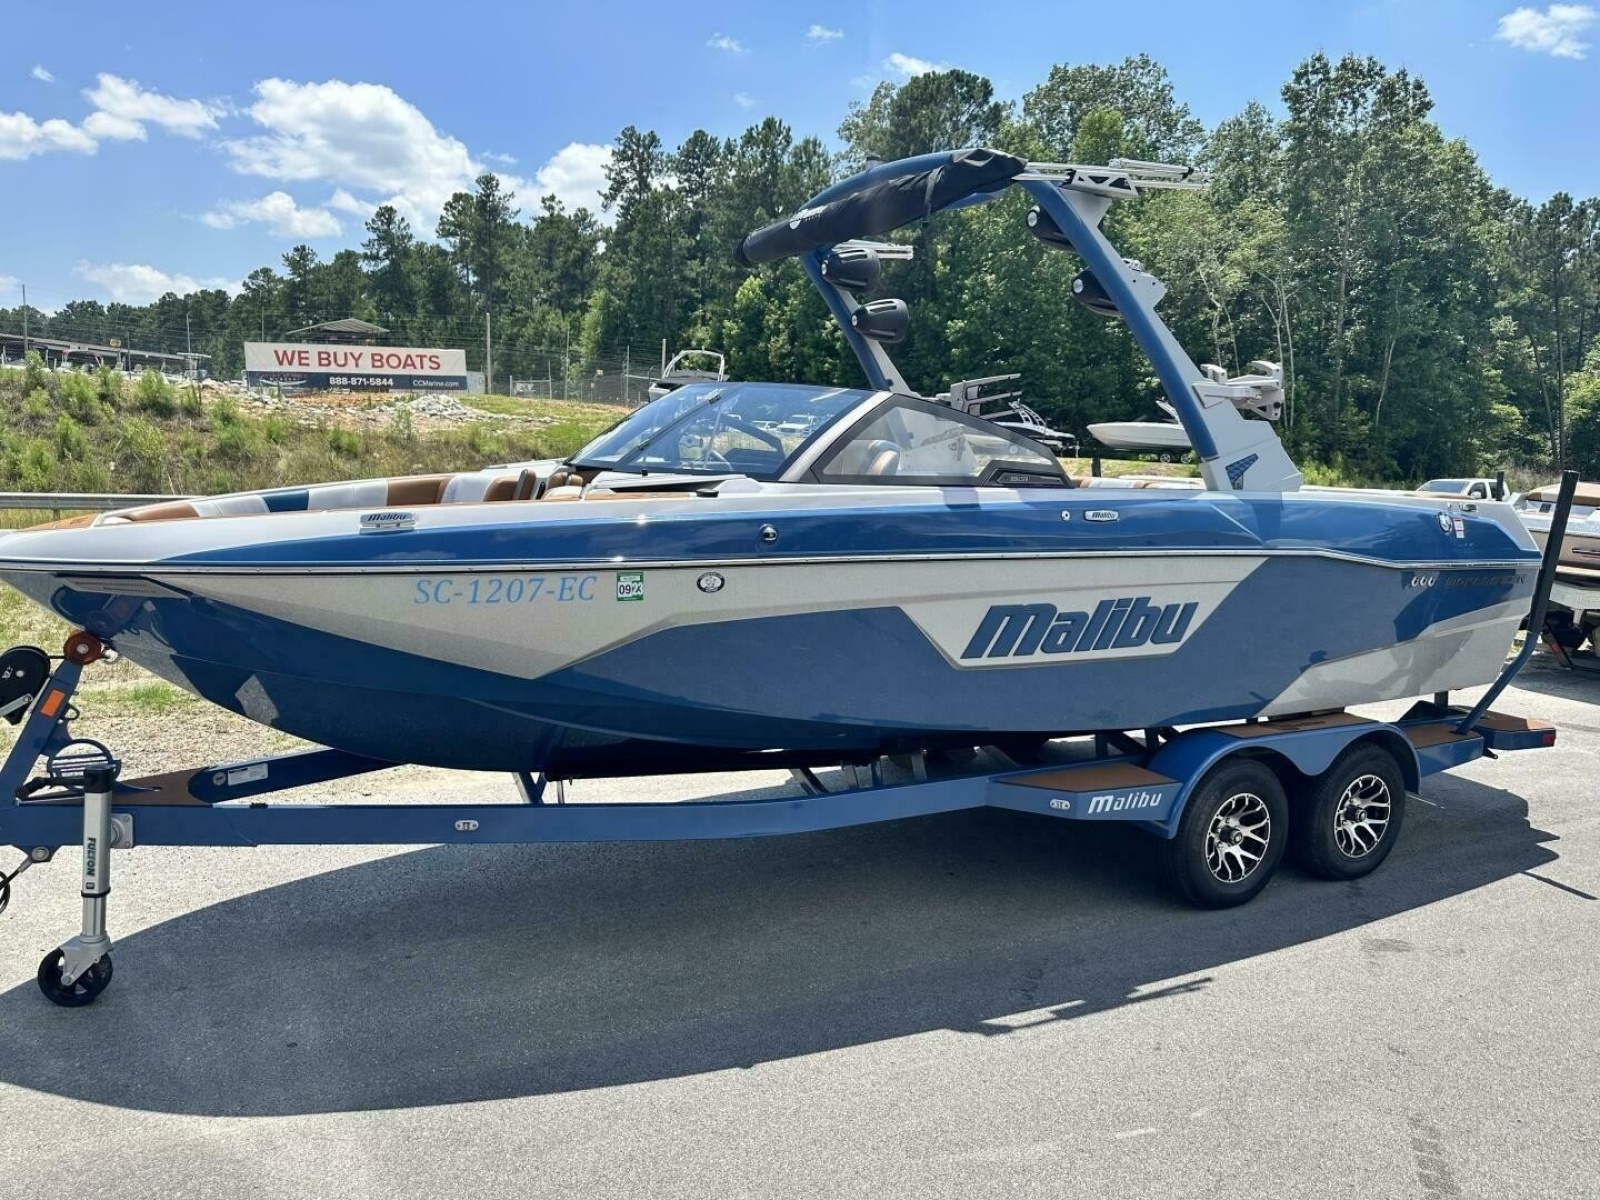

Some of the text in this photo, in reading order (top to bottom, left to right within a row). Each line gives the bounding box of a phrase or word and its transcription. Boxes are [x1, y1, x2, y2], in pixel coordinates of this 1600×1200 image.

[273, 349, 441, 371] WE BUY BOATS
[329, 376, 394, 387] 888-871-5844
[412, 380, 460, 388] CCMarine.com
[413, 575, 598, 604] SC-1207-EC
[960, 596, 1200, 660] Malibu
[1087, 791, 1163, 814] Malibu
[86, 837, 97, 877] FULTON
